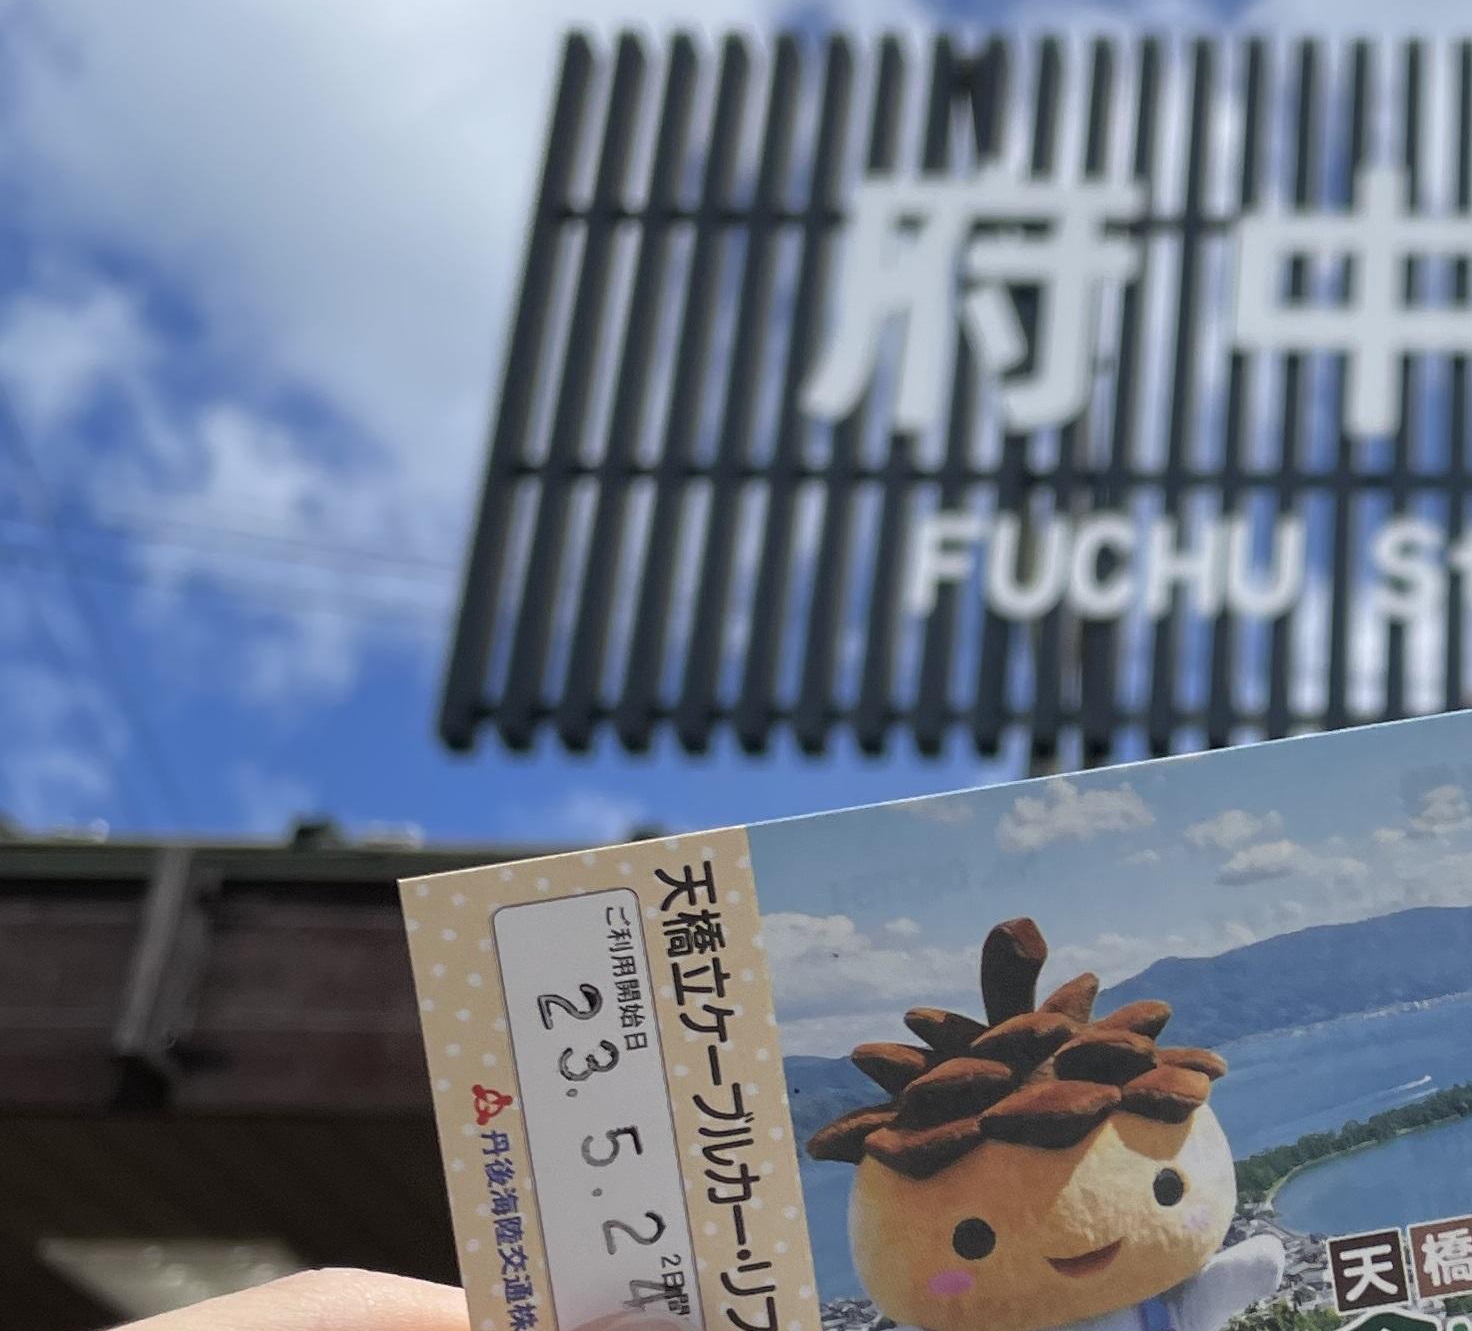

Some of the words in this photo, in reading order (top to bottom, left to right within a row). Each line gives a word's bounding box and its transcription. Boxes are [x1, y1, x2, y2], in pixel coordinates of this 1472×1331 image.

[908, 512, 1305, 619] FUCHU
[605, 905, 649, 1052] ご利用開始日
